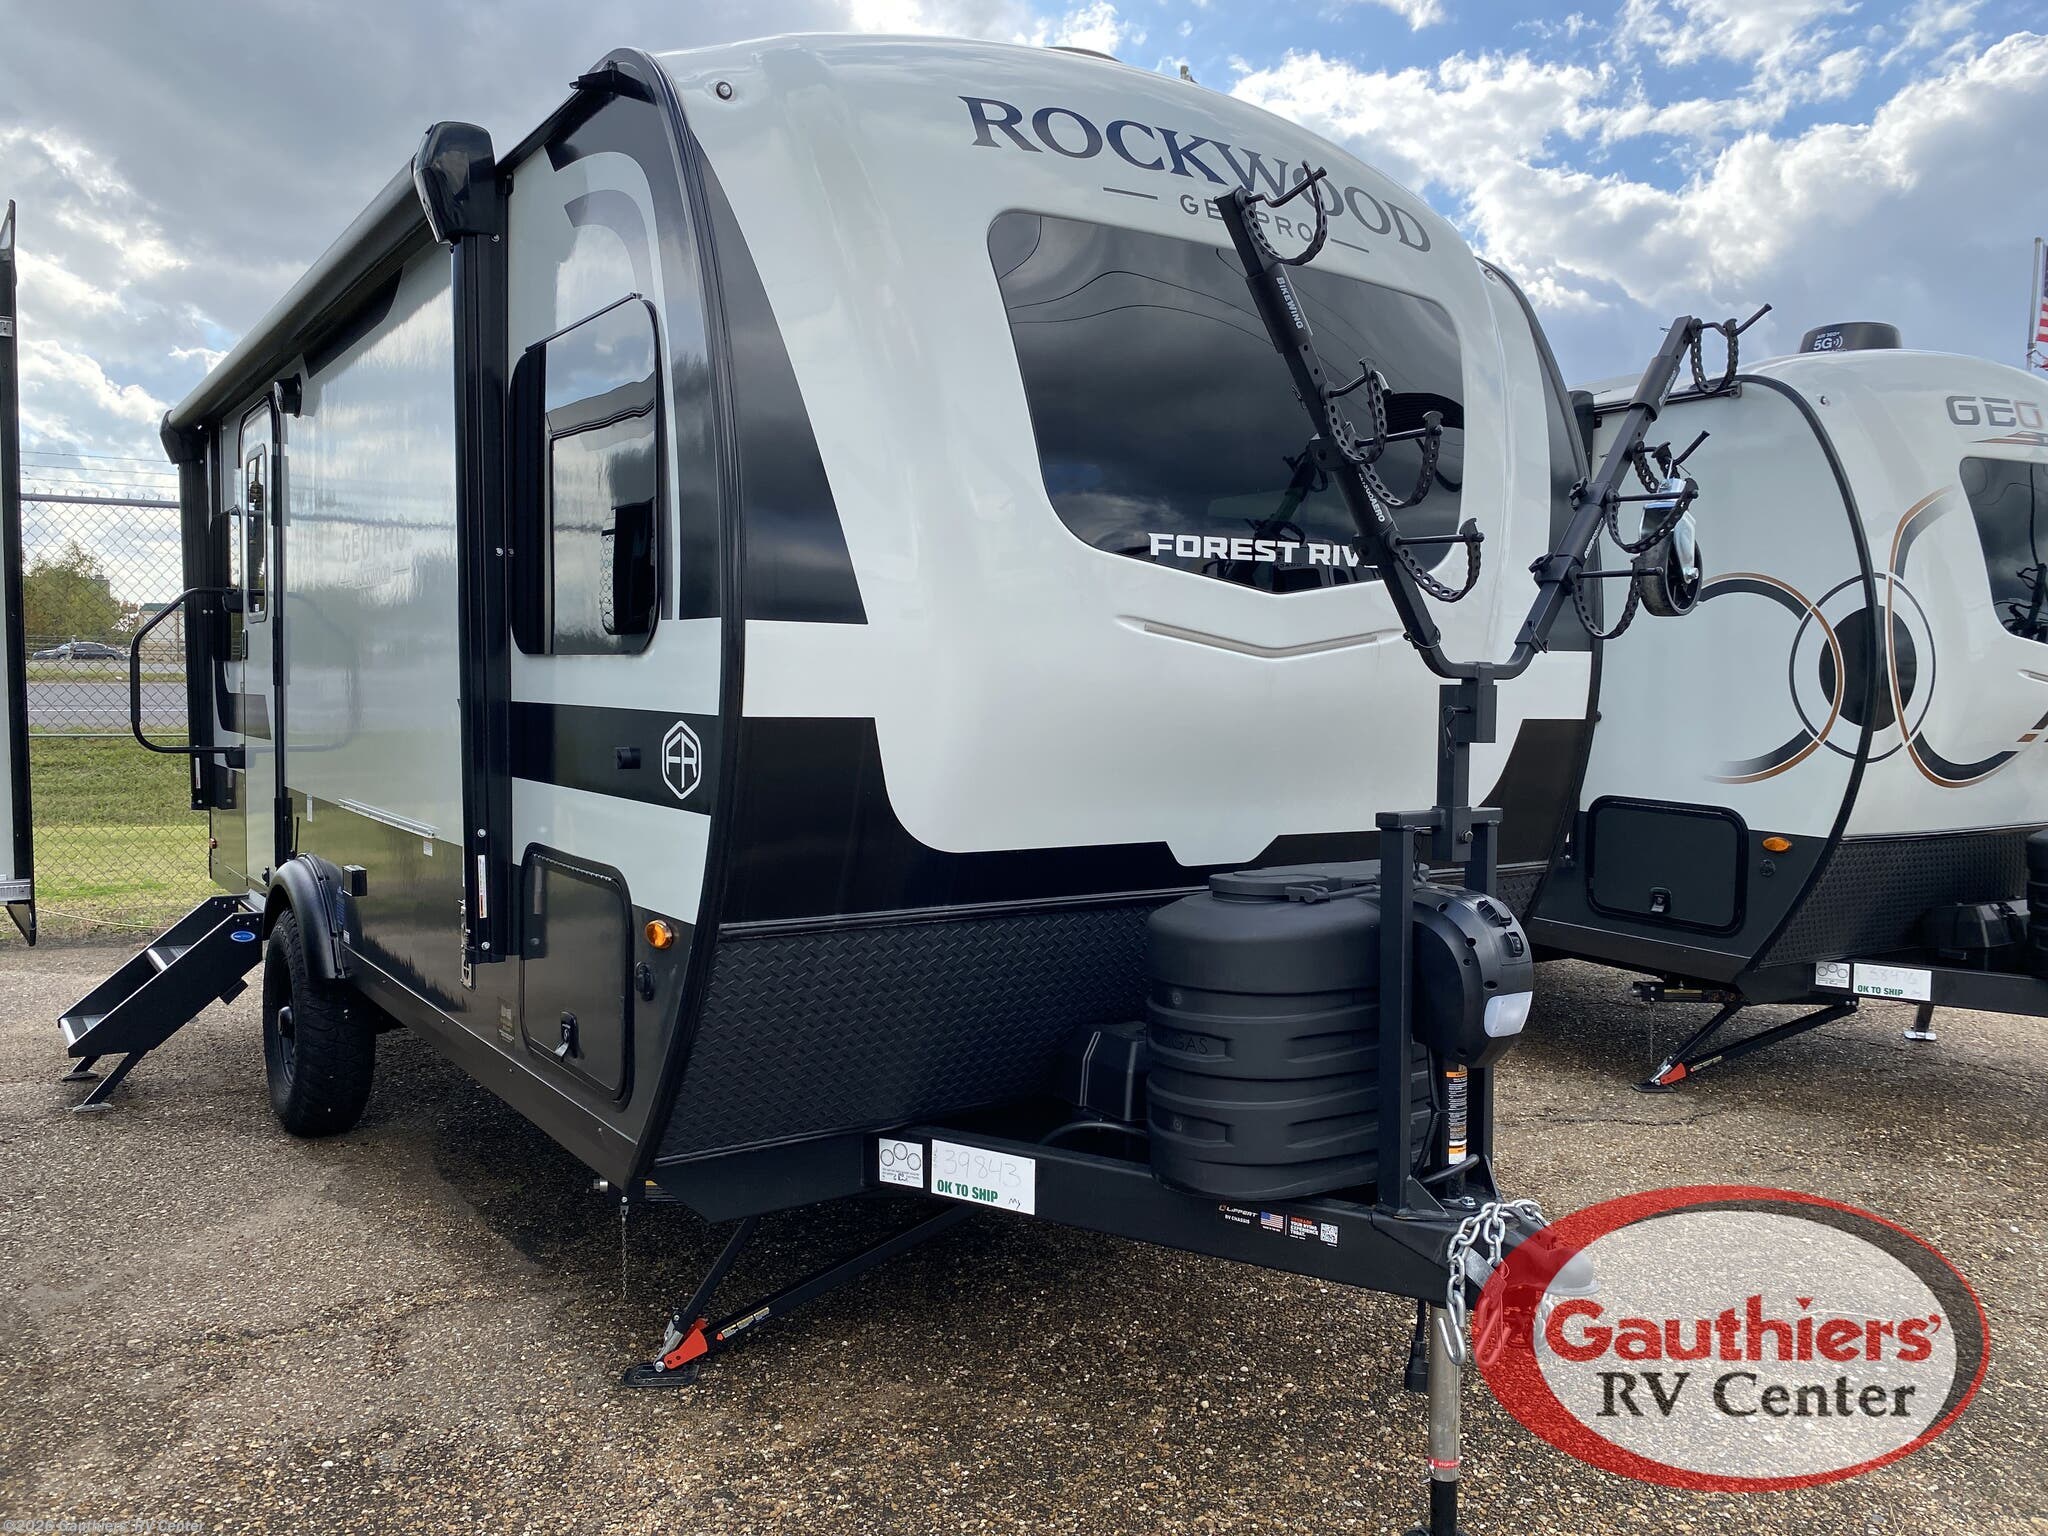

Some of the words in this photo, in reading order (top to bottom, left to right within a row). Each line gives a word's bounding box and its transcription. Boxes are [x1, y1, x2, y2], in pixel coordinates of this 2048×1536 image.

[957, 95, 1431, 252] ROCKWOOD
[1179, 194, 1314, 242] GEPRO
[1276, 276, 1304, 329] BIKEWING
[1813, 338, 1833, 350] 5G
[1946, 395, 2043, 429] GEO
[1148, 533, 1301, 562] FOREST
[1307, 543, 1379, 569] RIV
[1857, 985, 1869, 993] OK
[1870, 986, 1882, 994] TO
[1883, 987, 1904, 996] SHIP
[944, 1149, 1022, 1187] 39843
[937, 1179, 953, 1194] OK
[954, 1182, 969, 1197] TO
[971, 1186, 999, 1203] SHIP
